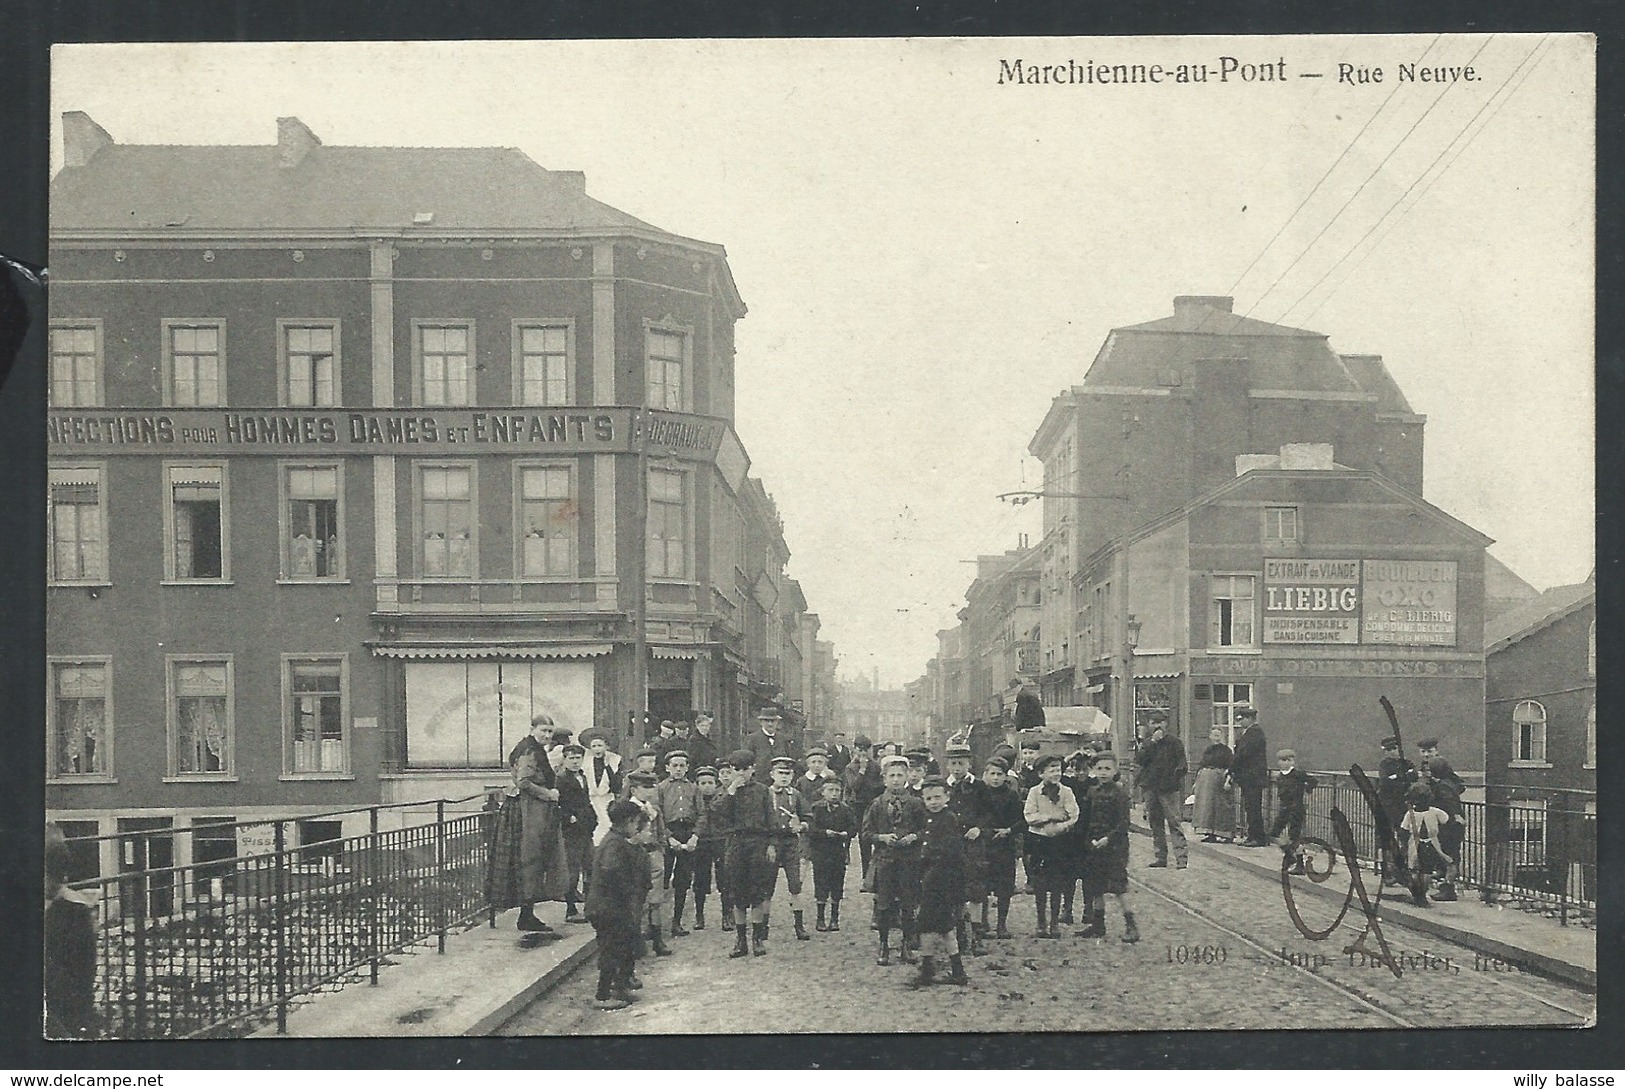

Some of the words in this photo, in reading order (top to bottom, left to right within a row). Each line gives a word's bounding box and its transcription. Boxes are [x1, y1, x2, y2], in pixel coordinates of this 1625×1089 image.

[182, 427, 218, 444] POUR
[224, 414, 338, 444] HOMMES
[349, 413, 440, 444] DAMES
[446, 427, 469, 444] ET
[472, 413, 616, 444] ENFANTS
[1268, 562, 1309, 579] EXTRAIT
[1319, 563, 1356, 579] VIANDE
[1366, 562, 1454, 582] BOUILLON
[1266, 587, 1357, 612] LIEBIG
[1377, 586, 1436, 608] OXO
[1269, 619, 1349, 630] INDISPENSABLE
[1406, 610, 1452, 622] LIEBIG
[1274, 631, 1296, 640] DANS
[1304, 631, 1340, 641] CUISINE
